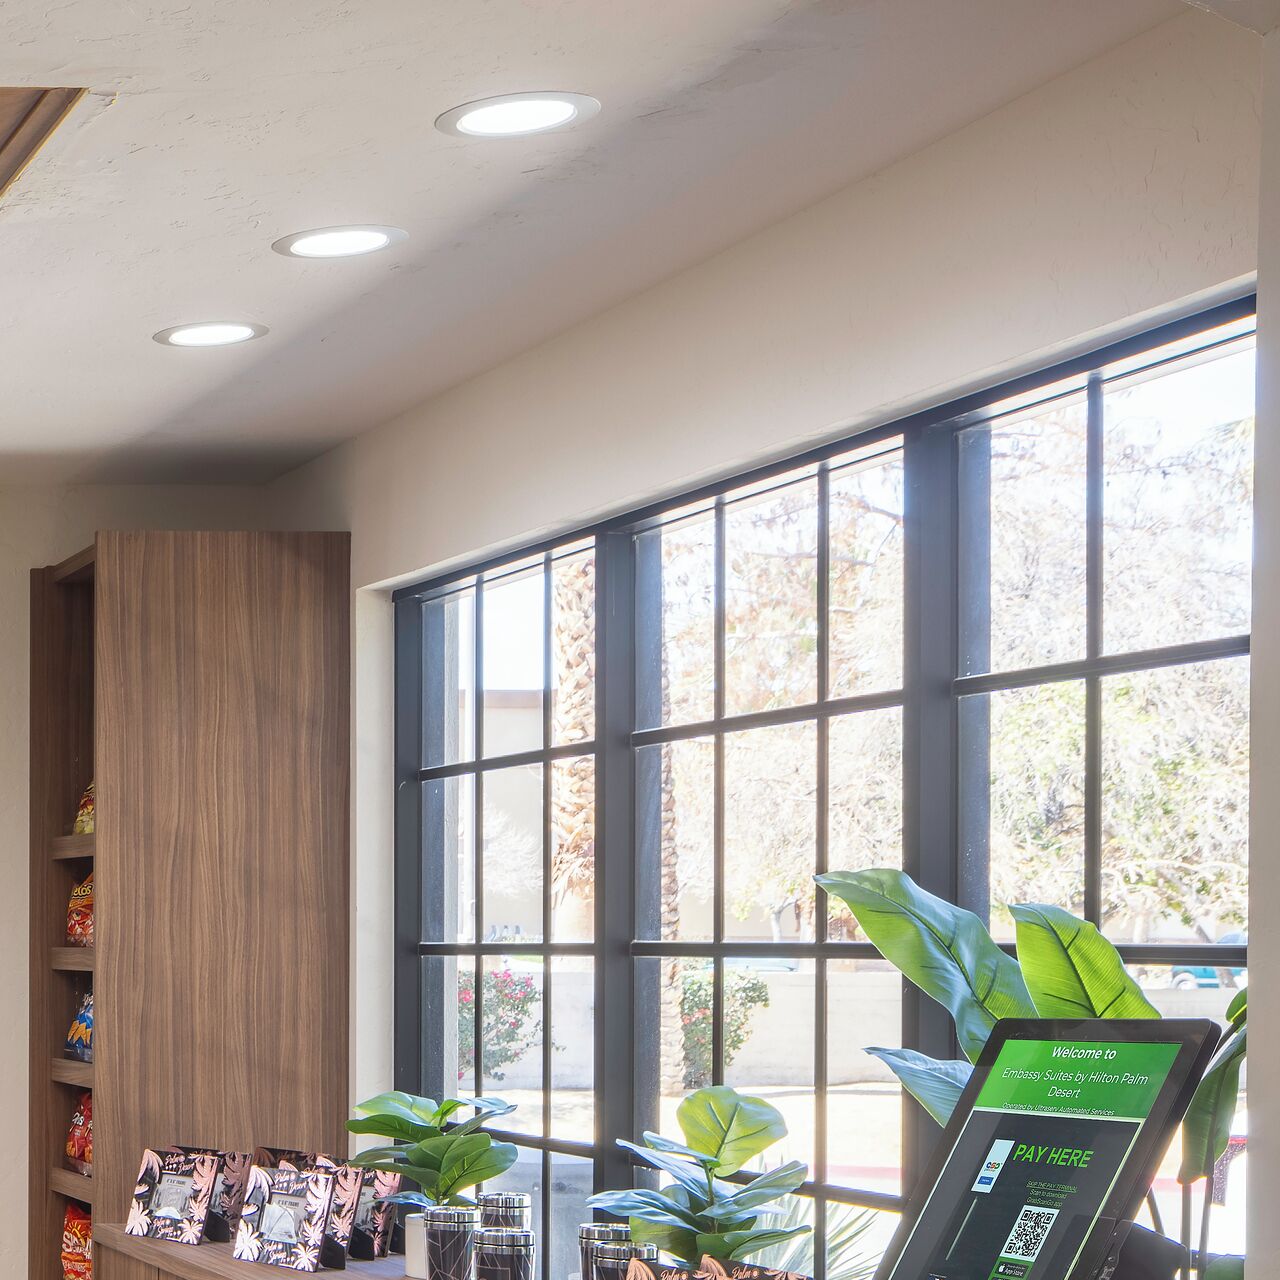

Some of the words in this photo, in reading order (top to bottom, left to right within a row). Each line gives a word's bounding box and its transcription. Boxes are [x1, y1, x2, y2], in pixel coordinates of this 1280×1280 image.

[1051, 1046, 1102, 1059] Welcome
[1104, 1048, 1117, 1060] to
[1002, 1068, 1042, 1082] Embassy
[1044, 1069, 1074, 1082] Suites
[1075, 1070, 1088, 1084] by
[1090, 1071, 1120, 1083] Hilton
[1121, 1073, 1148, 1085] Palm
[1048, 1086, 1080, 1098] Desert
[1003, 1102, 1027, 1111] Operated
[1027, 1103, 1034, 1112] by
[1035, 1104, 1058, 1112] Ultraserv
[1060, 1105, 1090, 1115] Automated
[1091, 1108, 1115, 1116] Services
[1013, 1144, 1048, 1163] PAY
[1047, 1147, 1095, 1168] HERE
[1056, 1183, 1077, 1192] TERMINAL
[1027, 1197, 1053, 1206] GrabScanGo
[1046, 1191, 1067, 1199] download
[732, 1266, 752, 1280] Palm
